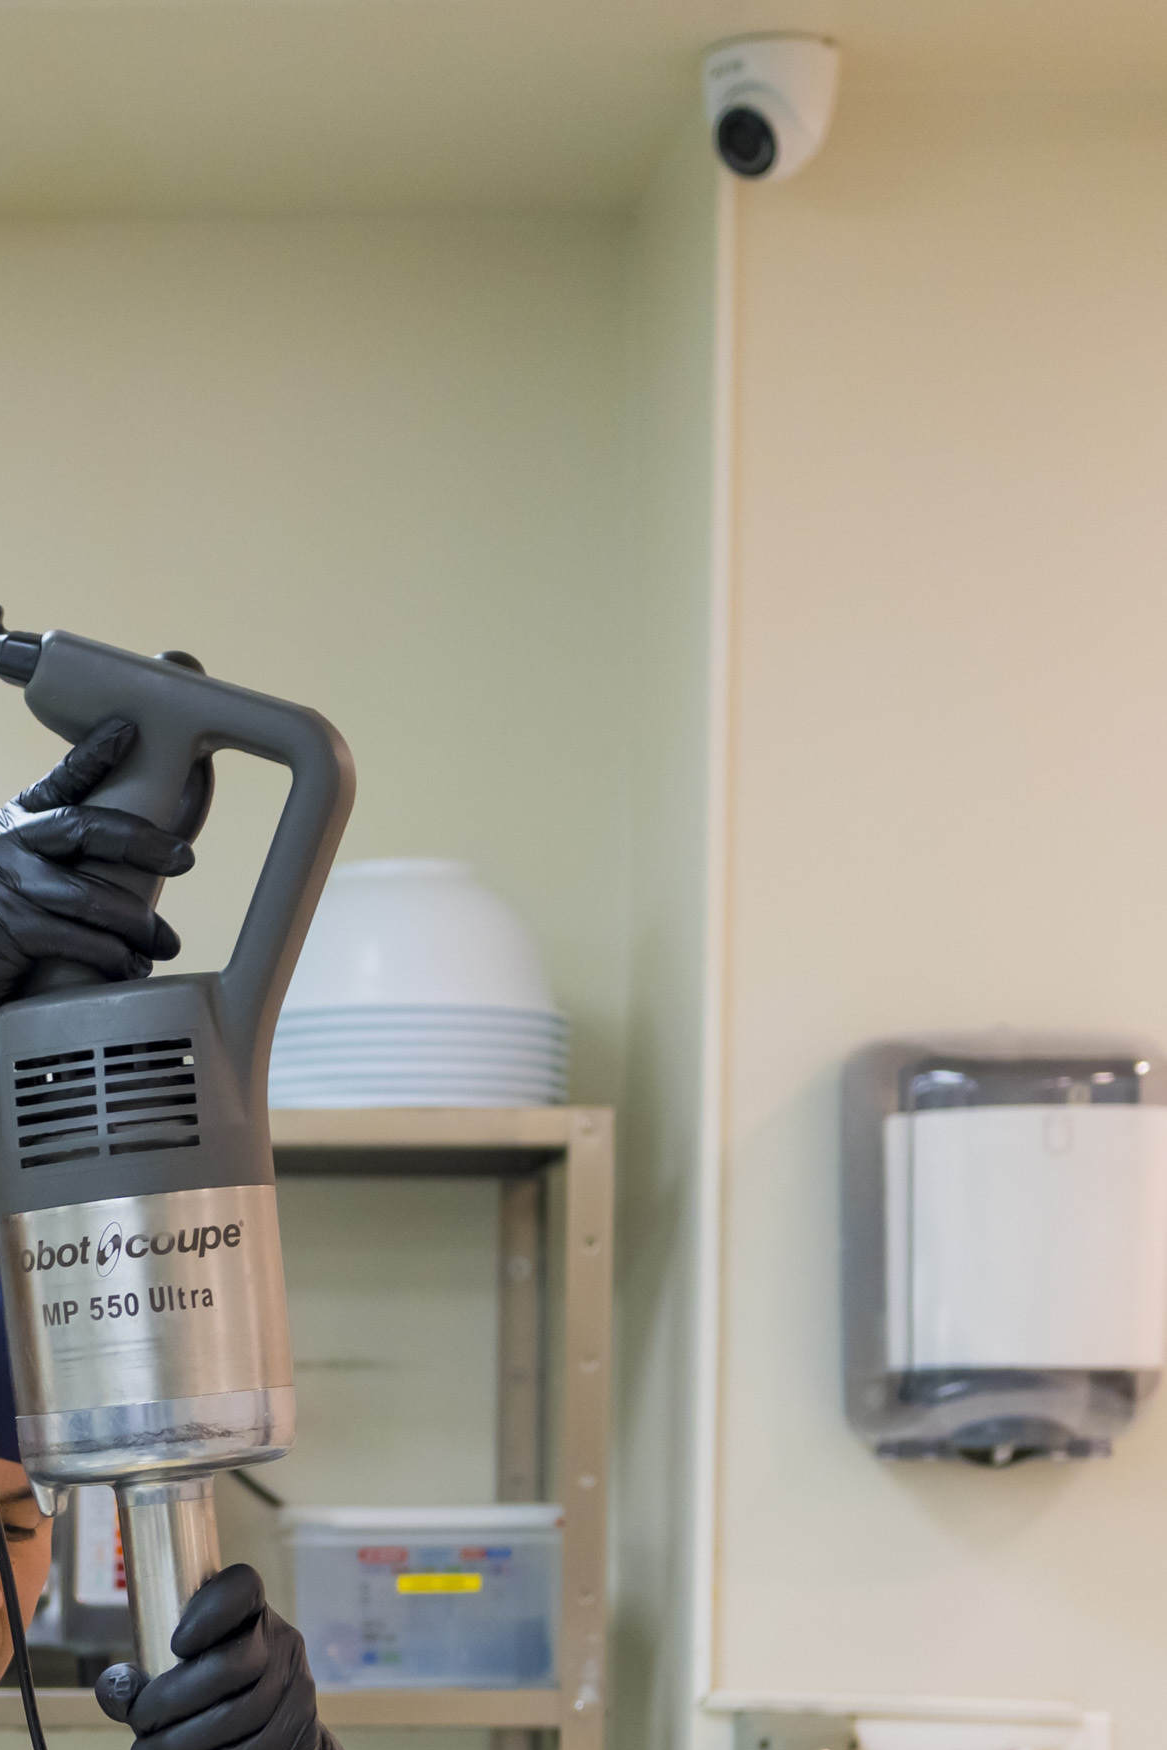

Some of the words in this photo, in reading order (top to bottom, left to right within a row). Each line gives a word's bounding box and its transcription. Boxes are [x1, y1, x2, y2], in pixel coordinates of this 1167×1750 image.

[20, 1235, 91, 1274] obot
[42, 1300, 79, 1328] MP
[89, 1292, 139, 1321] 550
[147, 1285, 214, 1314] Ultra
